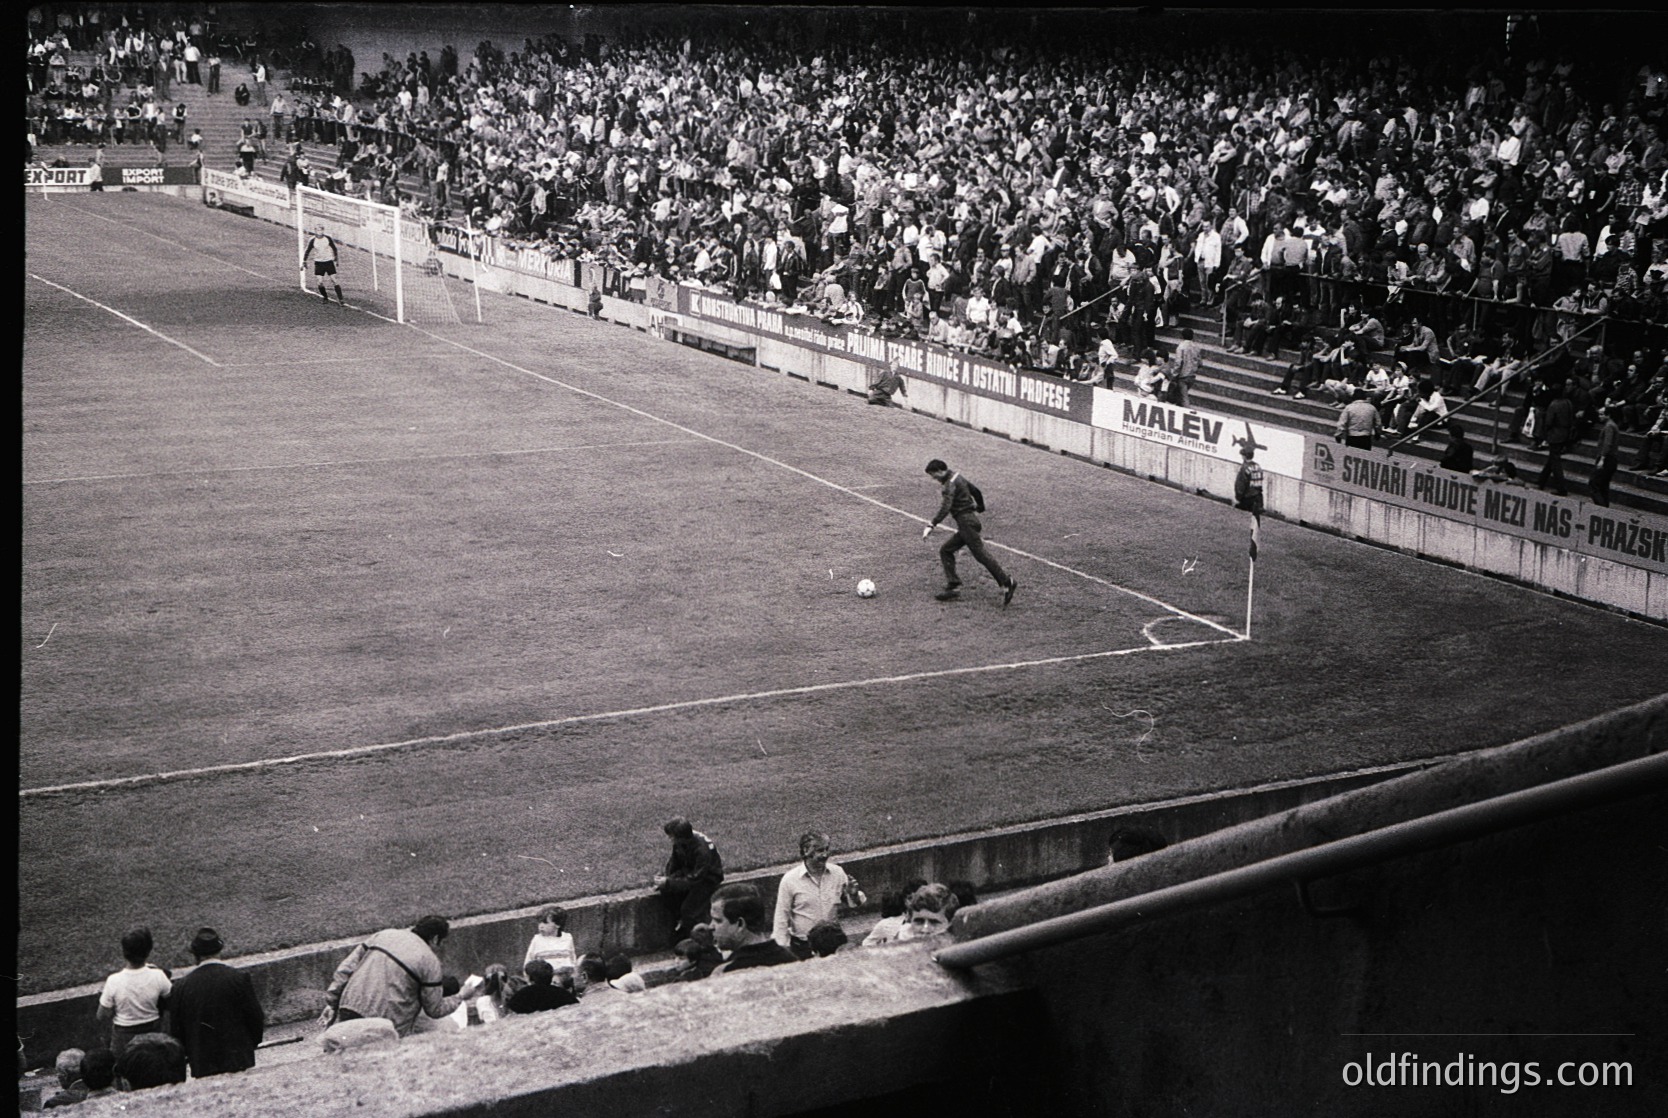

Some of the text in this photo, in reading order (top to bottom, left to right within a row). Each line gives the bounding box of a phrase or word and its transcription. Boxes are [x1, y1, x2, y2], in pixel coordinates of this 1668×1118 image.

[122, 168, 164, 176] EXPORT
[122, 175, 165, 183] IMPORT
[962, 361, 970, 386] A
[1020, 376, 1071, 411] PROFESE
[1122, 422, 1218, 454] Hungarian Airlines
[1342, 454, 1407, 497] STAVAŘI
[1484, 489, 1527, 528] MEZI
[1533, 500, 1572, 538] NÁS
